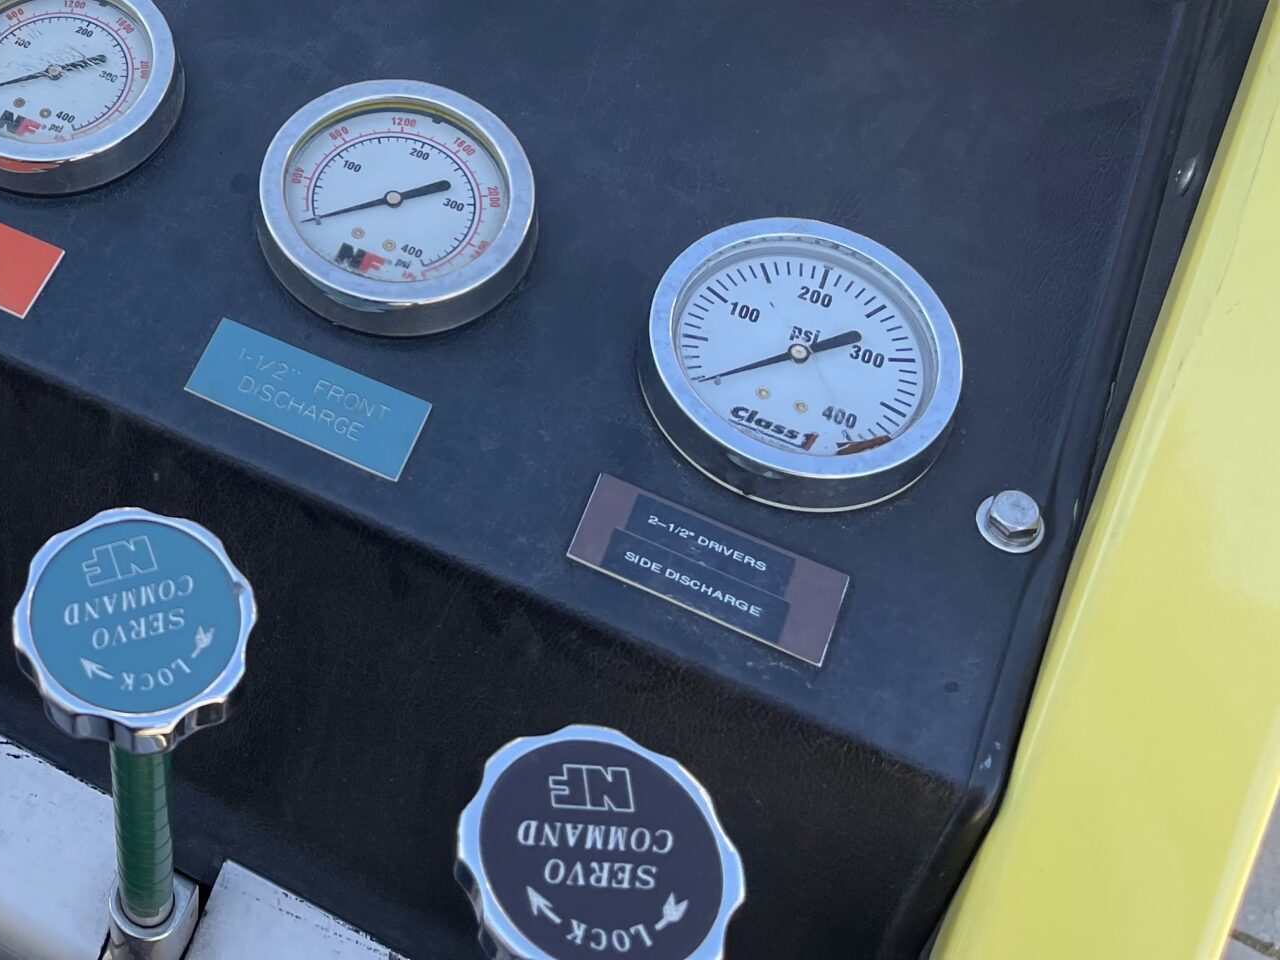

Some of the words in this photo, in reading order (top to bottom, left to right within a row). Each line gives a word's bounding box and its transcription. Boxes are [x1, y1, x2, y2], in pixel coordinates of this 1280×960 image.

[63, 0, 86, 10] 1200
[74, 26, 94, 38] 200
[55, 111, 75, 123] 400
[391, 116, 417, 128] 1200
[329, 125, 349, 141] 800
[409, 147, 430, 162] 200
[452, 136, 476, 157] 1600
[342, 159, 362, 173] 100
[442, 197, 465, 213] 300
[487, 185, 501, 208] 2000
[400, 243, 424, 259] 400
[394, 258, 413, 270] psi
[797, 285, 833, 309] 200
[729, 300, 761, 324] 100
[849, 344, 885, 369] 300
[238, 375, 365, 441] DISCHARGE
[313, 379, 393, 418] FRONT
[729, 405, 820, 451] Class1
[821, 405, 858, 429] 400
[81, 534, 158, 587] NF
[697, 535, 767, 571] DRIVERS
[624, 550, 662, 574] SIDE
[665, 568, 763, 618] DISCHARGE
[63, 574, 195, 626] COMMAND
[91, 607, 186, 650] SERVO
[121, 657, 193, 691] LOCK
[548, 763, 635, 813] NF
[517, 819, 673, 854] COMMAND
[544, 857, 658, 889] SERVO
[566, 919, 653, 953] LOCK
